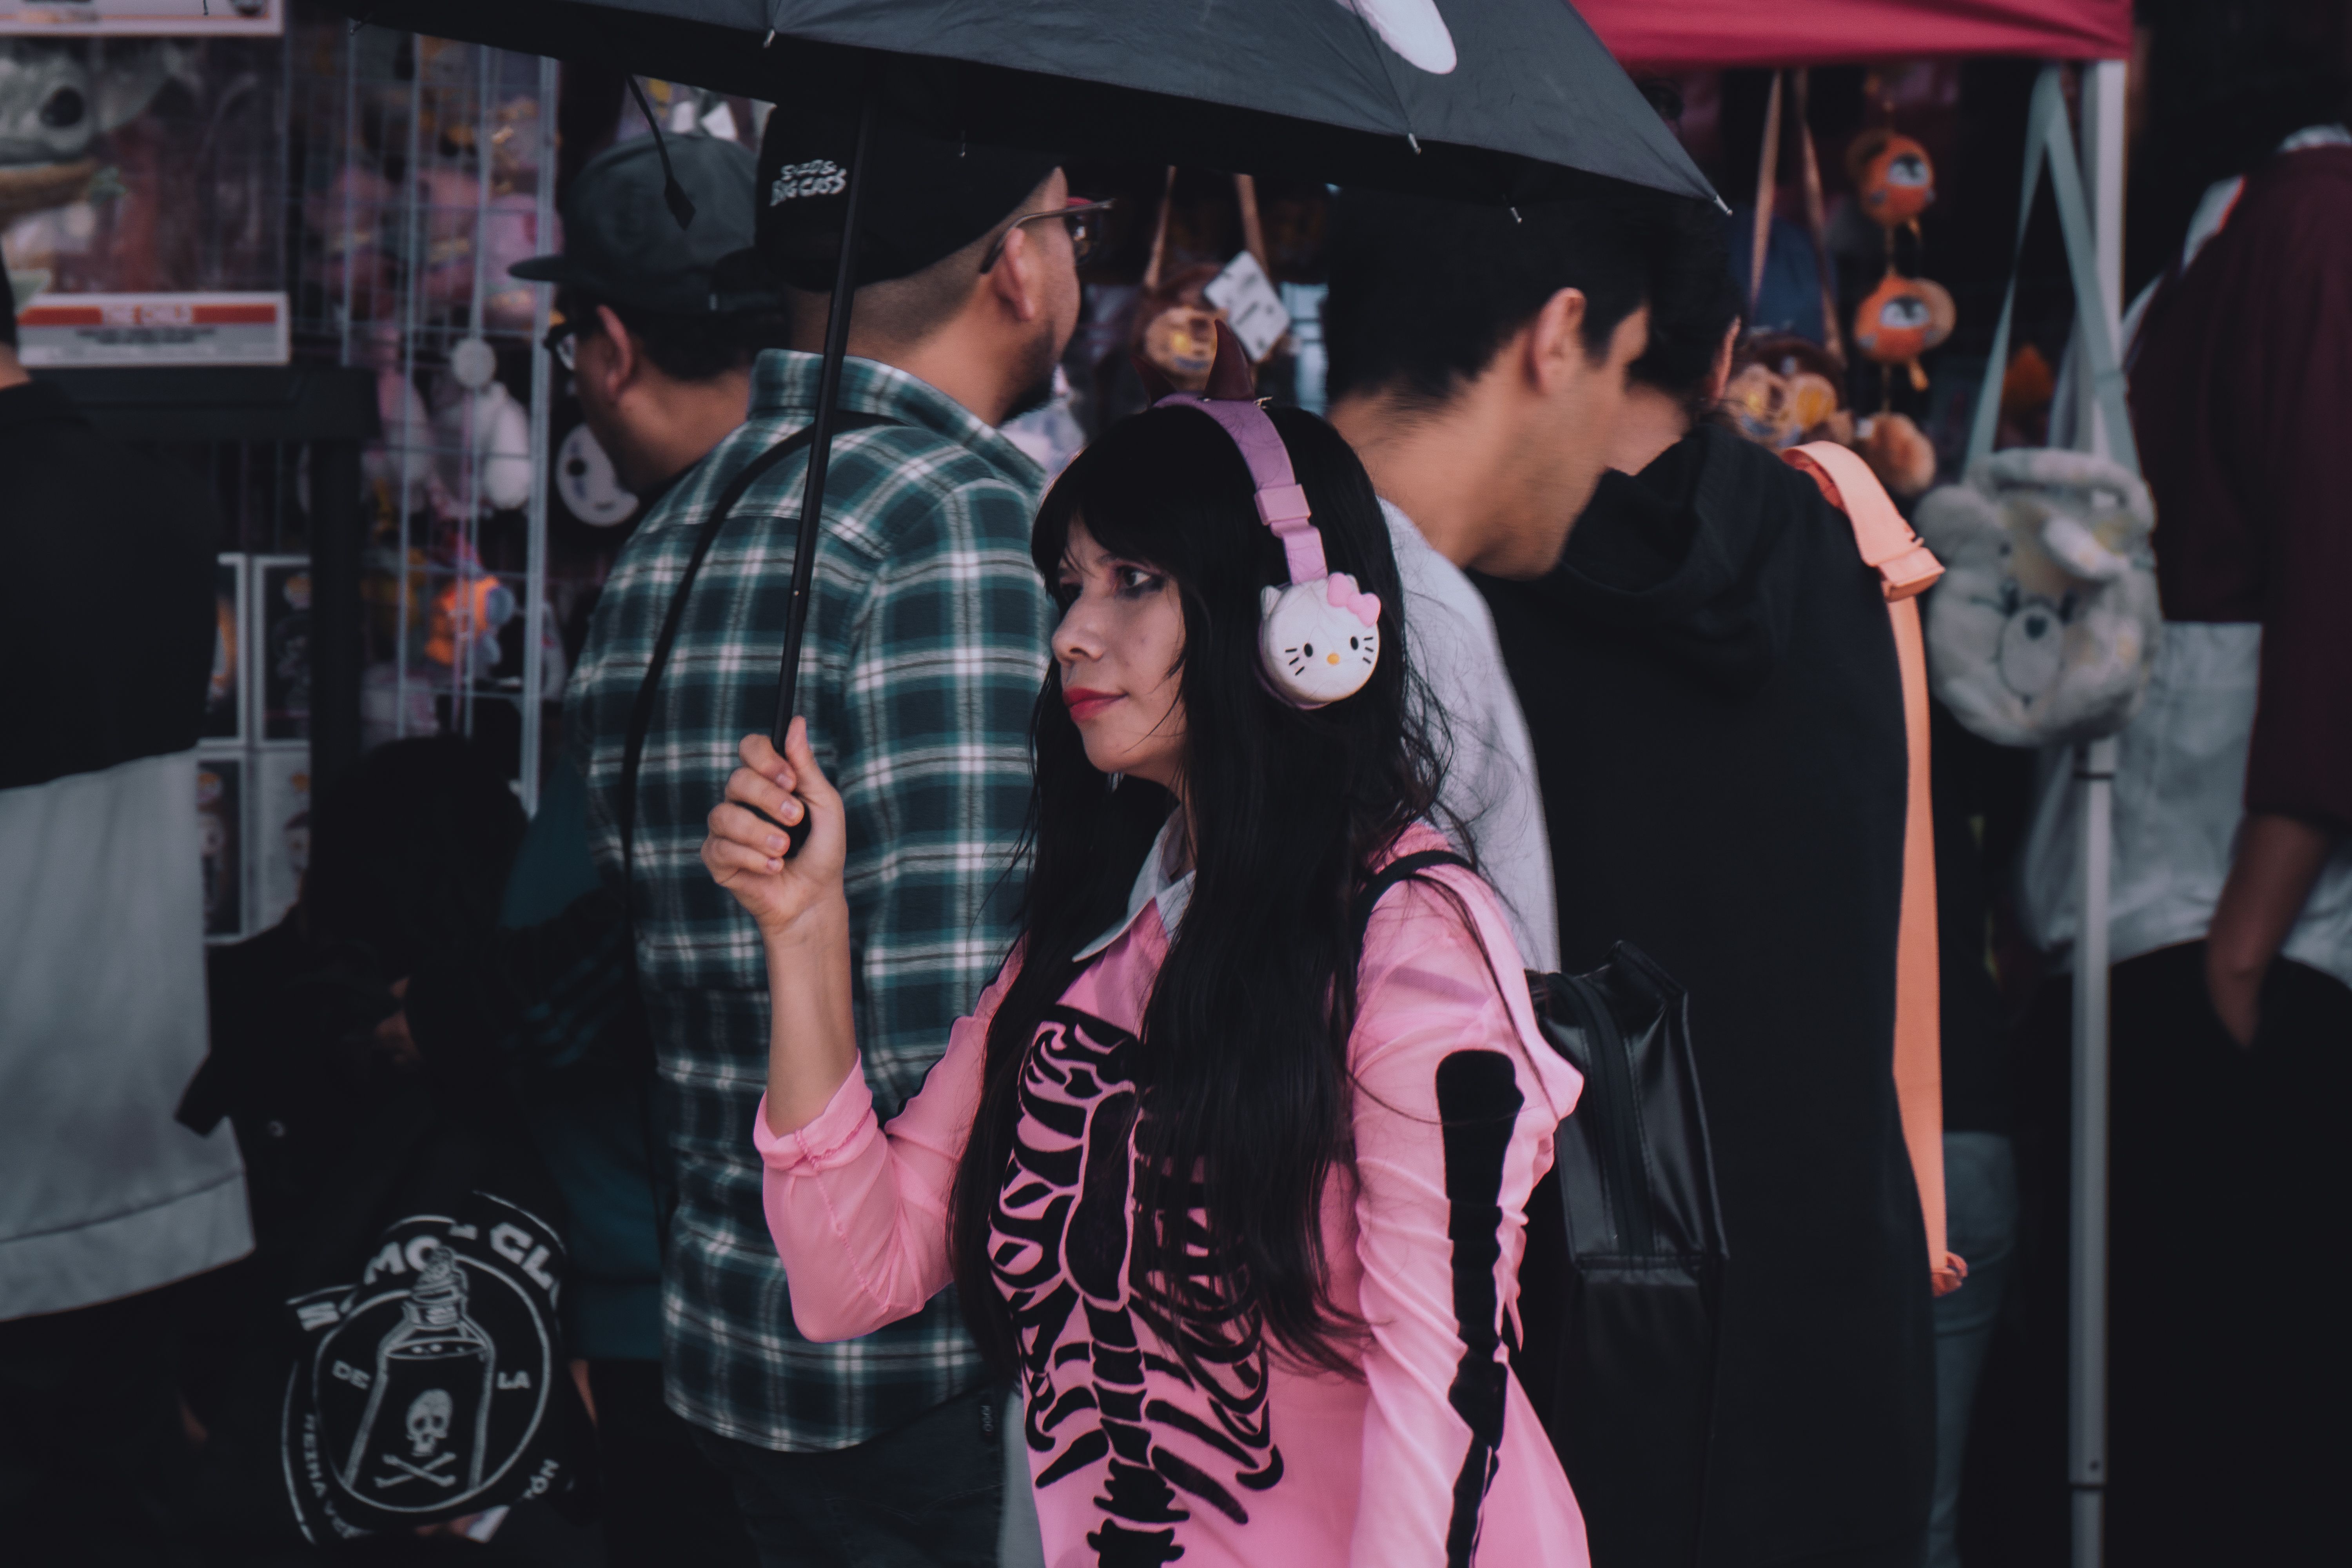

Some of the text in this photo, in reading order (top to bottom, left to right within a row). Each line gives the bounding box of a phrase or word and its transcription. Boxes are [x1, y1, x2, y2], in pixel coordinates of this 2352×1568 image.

[489, 1220, 555, 1291] CL
[331, 1359, 372, 1391] DE
[497, 1370, 532, 1390] LA
